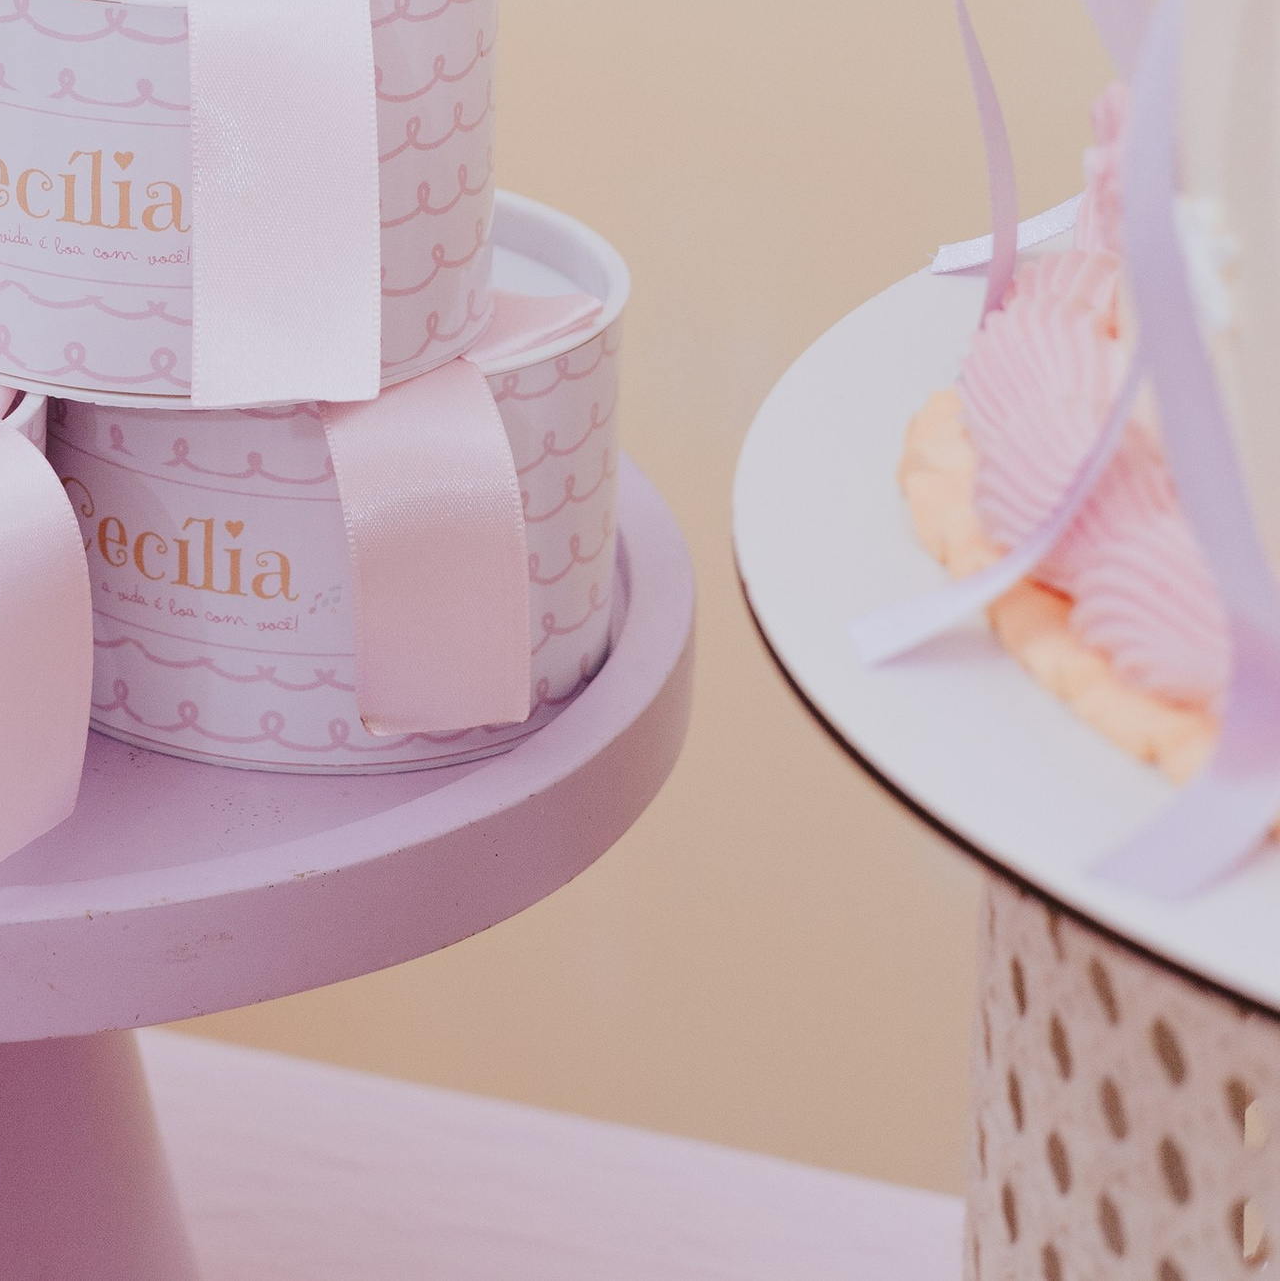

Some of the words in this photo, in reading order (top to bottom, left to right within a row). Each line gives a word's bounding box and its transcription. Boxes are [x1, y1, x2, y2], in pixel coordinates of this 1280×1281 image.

[0, 224, 32, 246] vida
[38, 236, 48, 249] é
[54, 236, 85, 255] boa
[92, 246, 138, 261] com
[147, 245, 191, 266] você!
[169, 598, 198, 618] boa
[205, 611, 248, 626] com
[256, 614, 299, 634] você!
